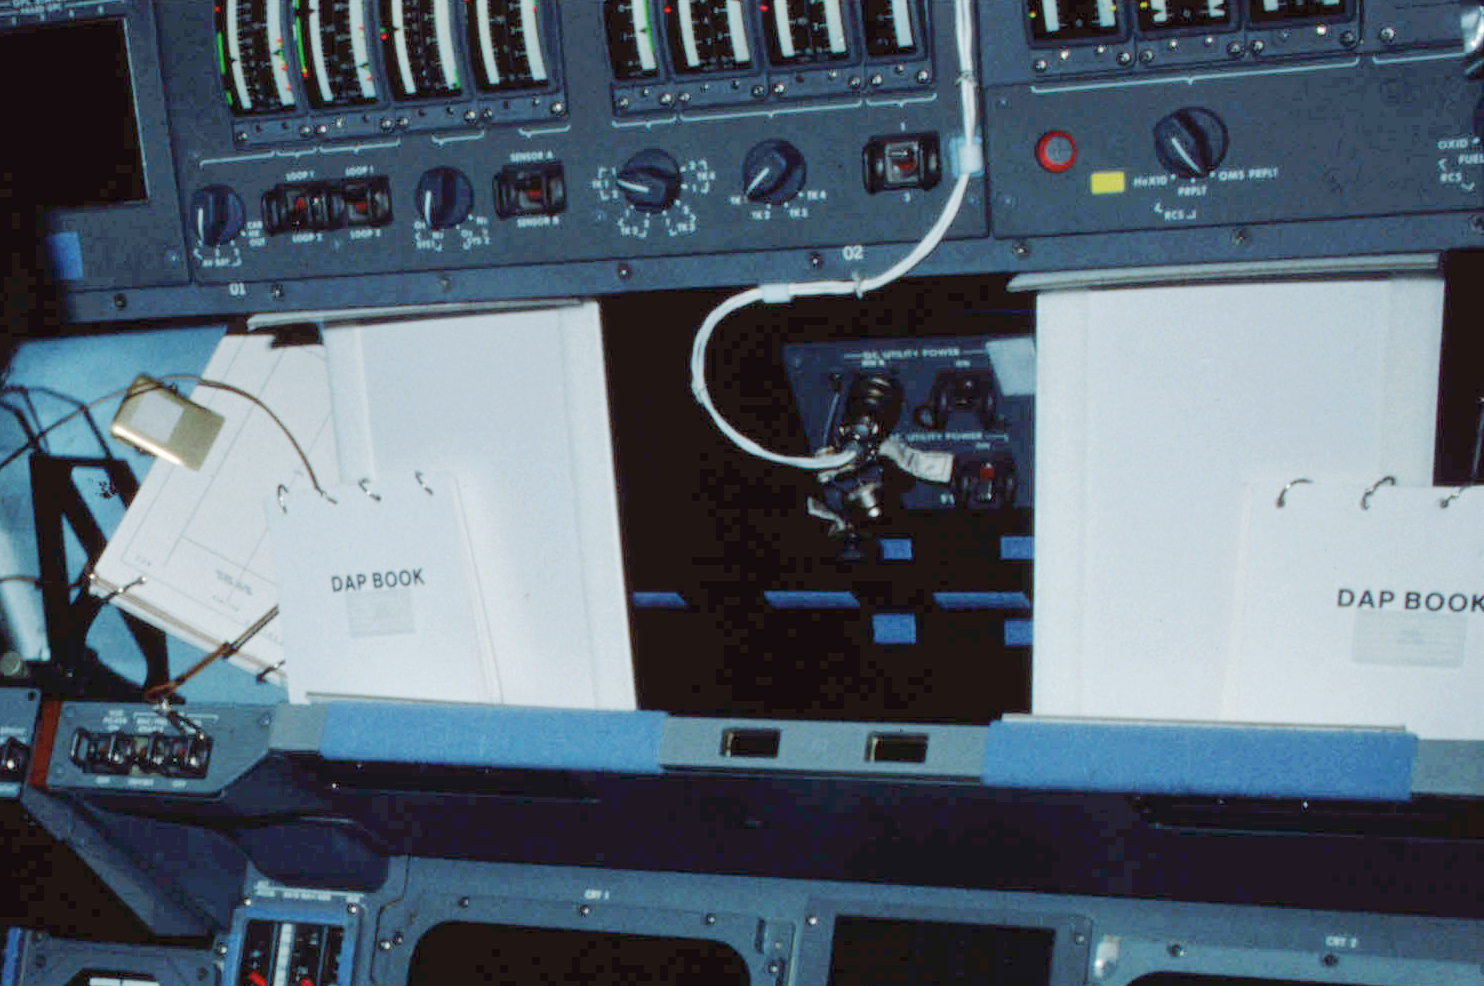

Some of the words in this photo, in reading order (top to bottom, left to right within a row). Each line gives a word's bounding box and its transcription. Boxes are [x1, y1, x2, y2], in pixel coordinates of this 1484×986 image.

[1218, 170, 1244, 181] OMS
[881, 349, 918, 360] UTILITY
[922, 347, 960, 358] POWER
[945, 431, 983, 440] POWER
[331, 574, 366, 592] DAP
[373, 568, 425, 589] BOOK
[1337, 589, 1395, 608] DAP
[1404, 591, 1484, 613] BOOK
